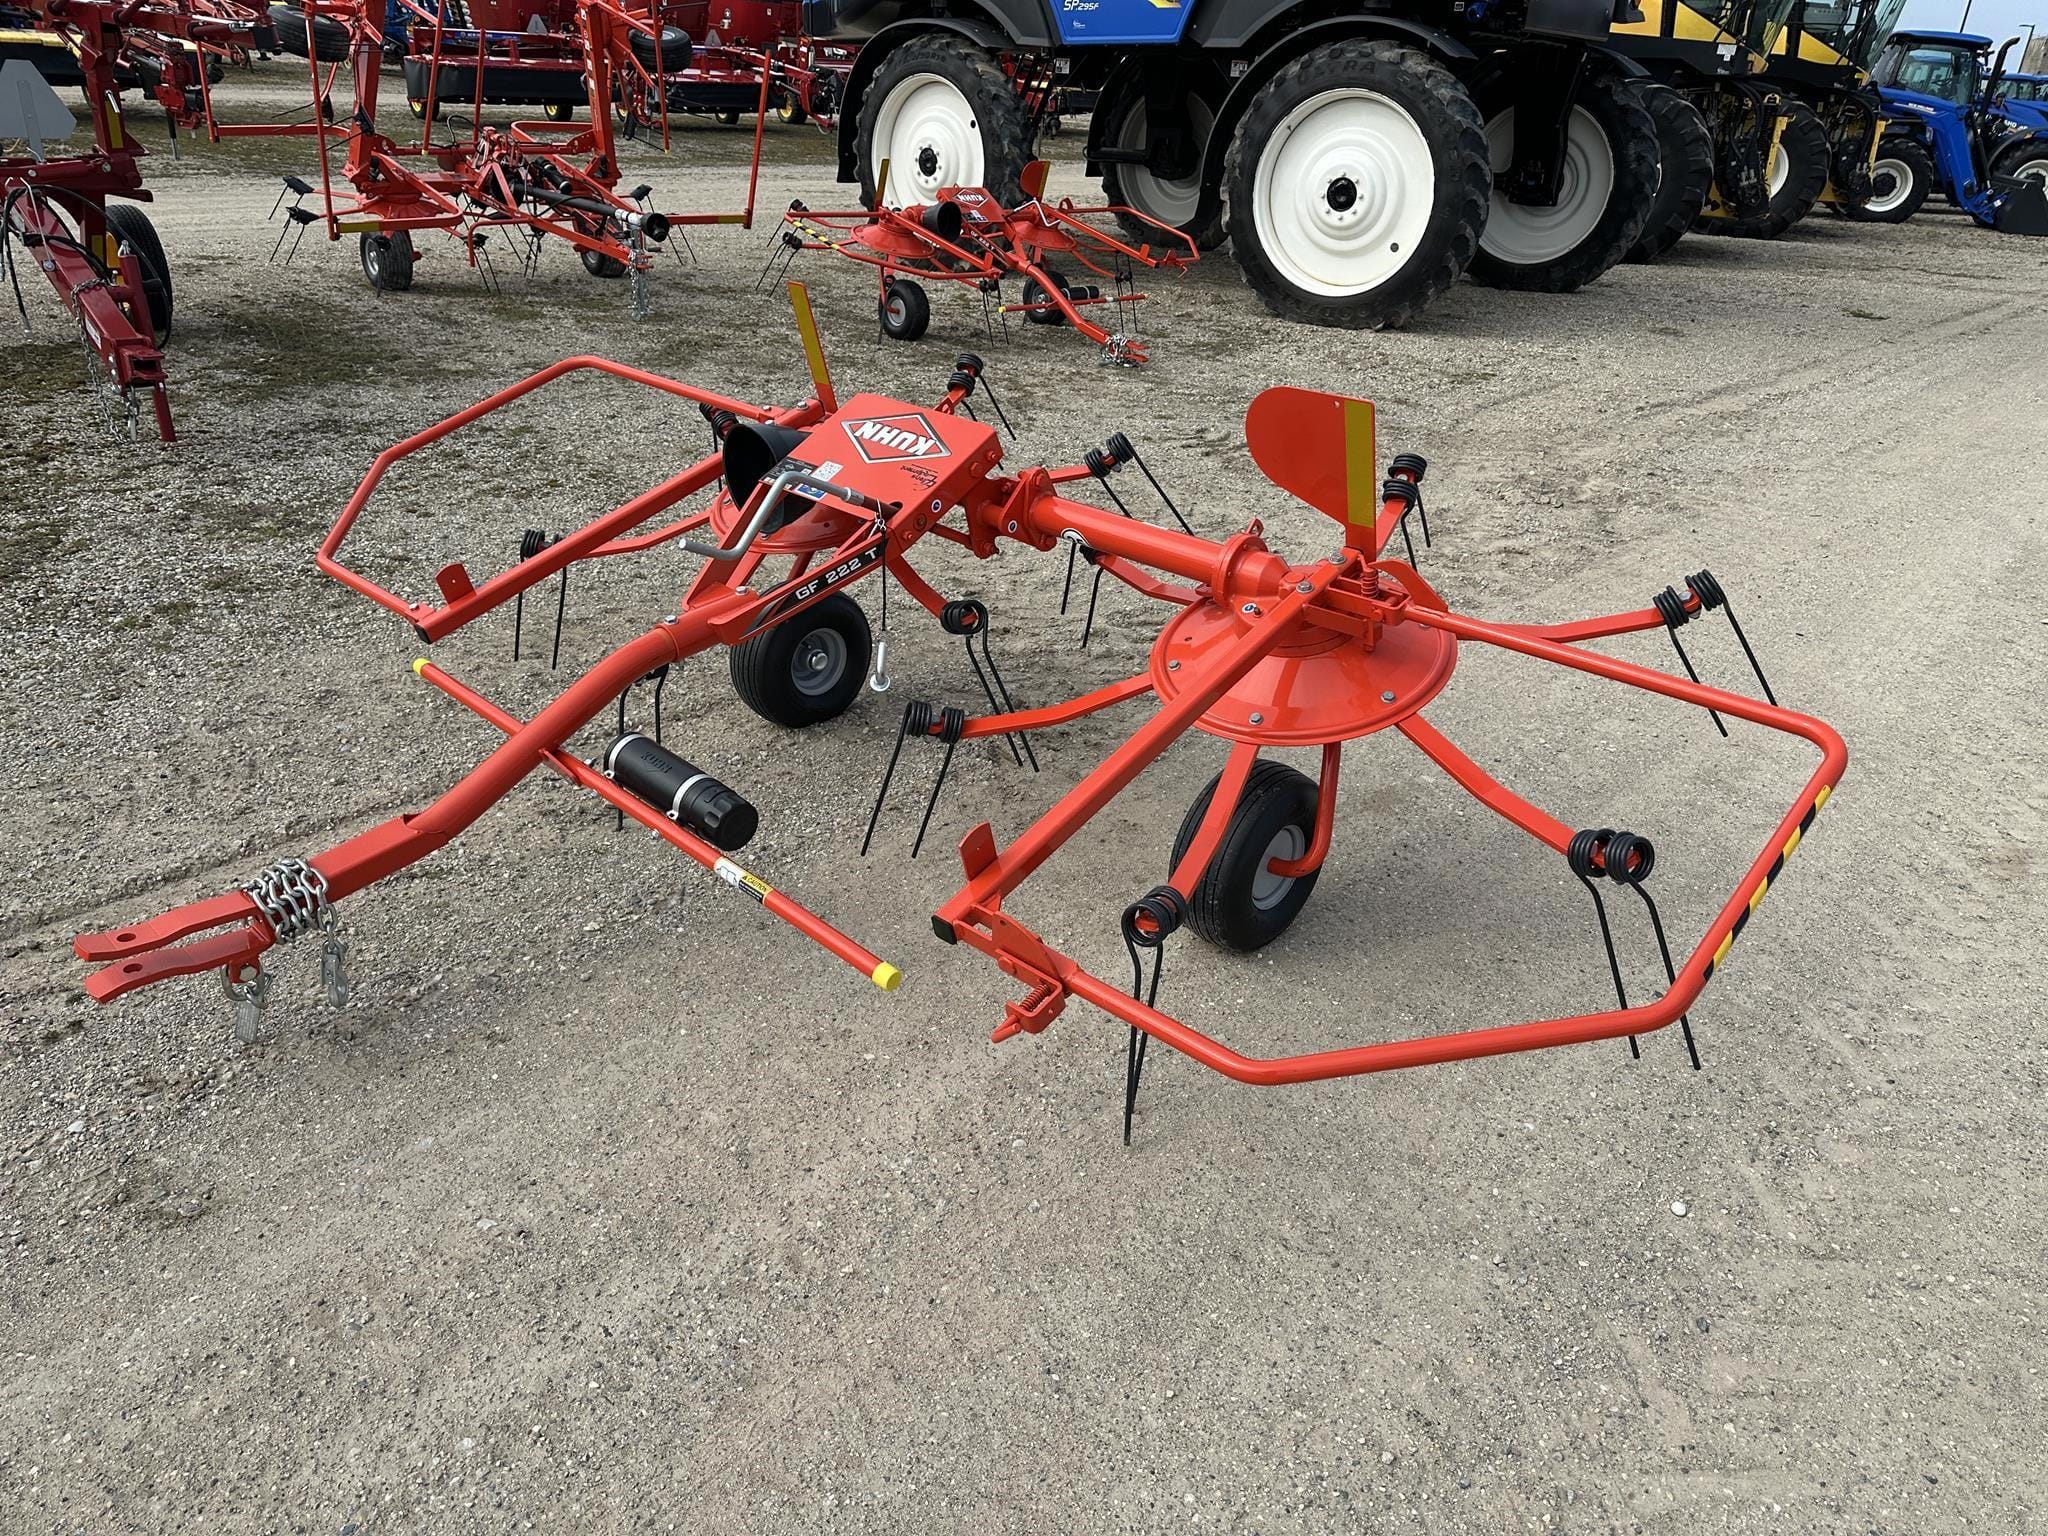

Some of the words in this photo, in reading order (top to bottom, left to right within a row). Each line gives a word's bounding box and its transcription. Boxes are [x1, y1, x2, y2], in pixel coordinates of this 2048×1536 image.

[957, 194, 985, 202] KUHN
[854, 420, 937, 456] KUHN
[795, 579, 819, 600] GF
[825, 558, 862, 584] 222
[864, 547, 877, 560] T
